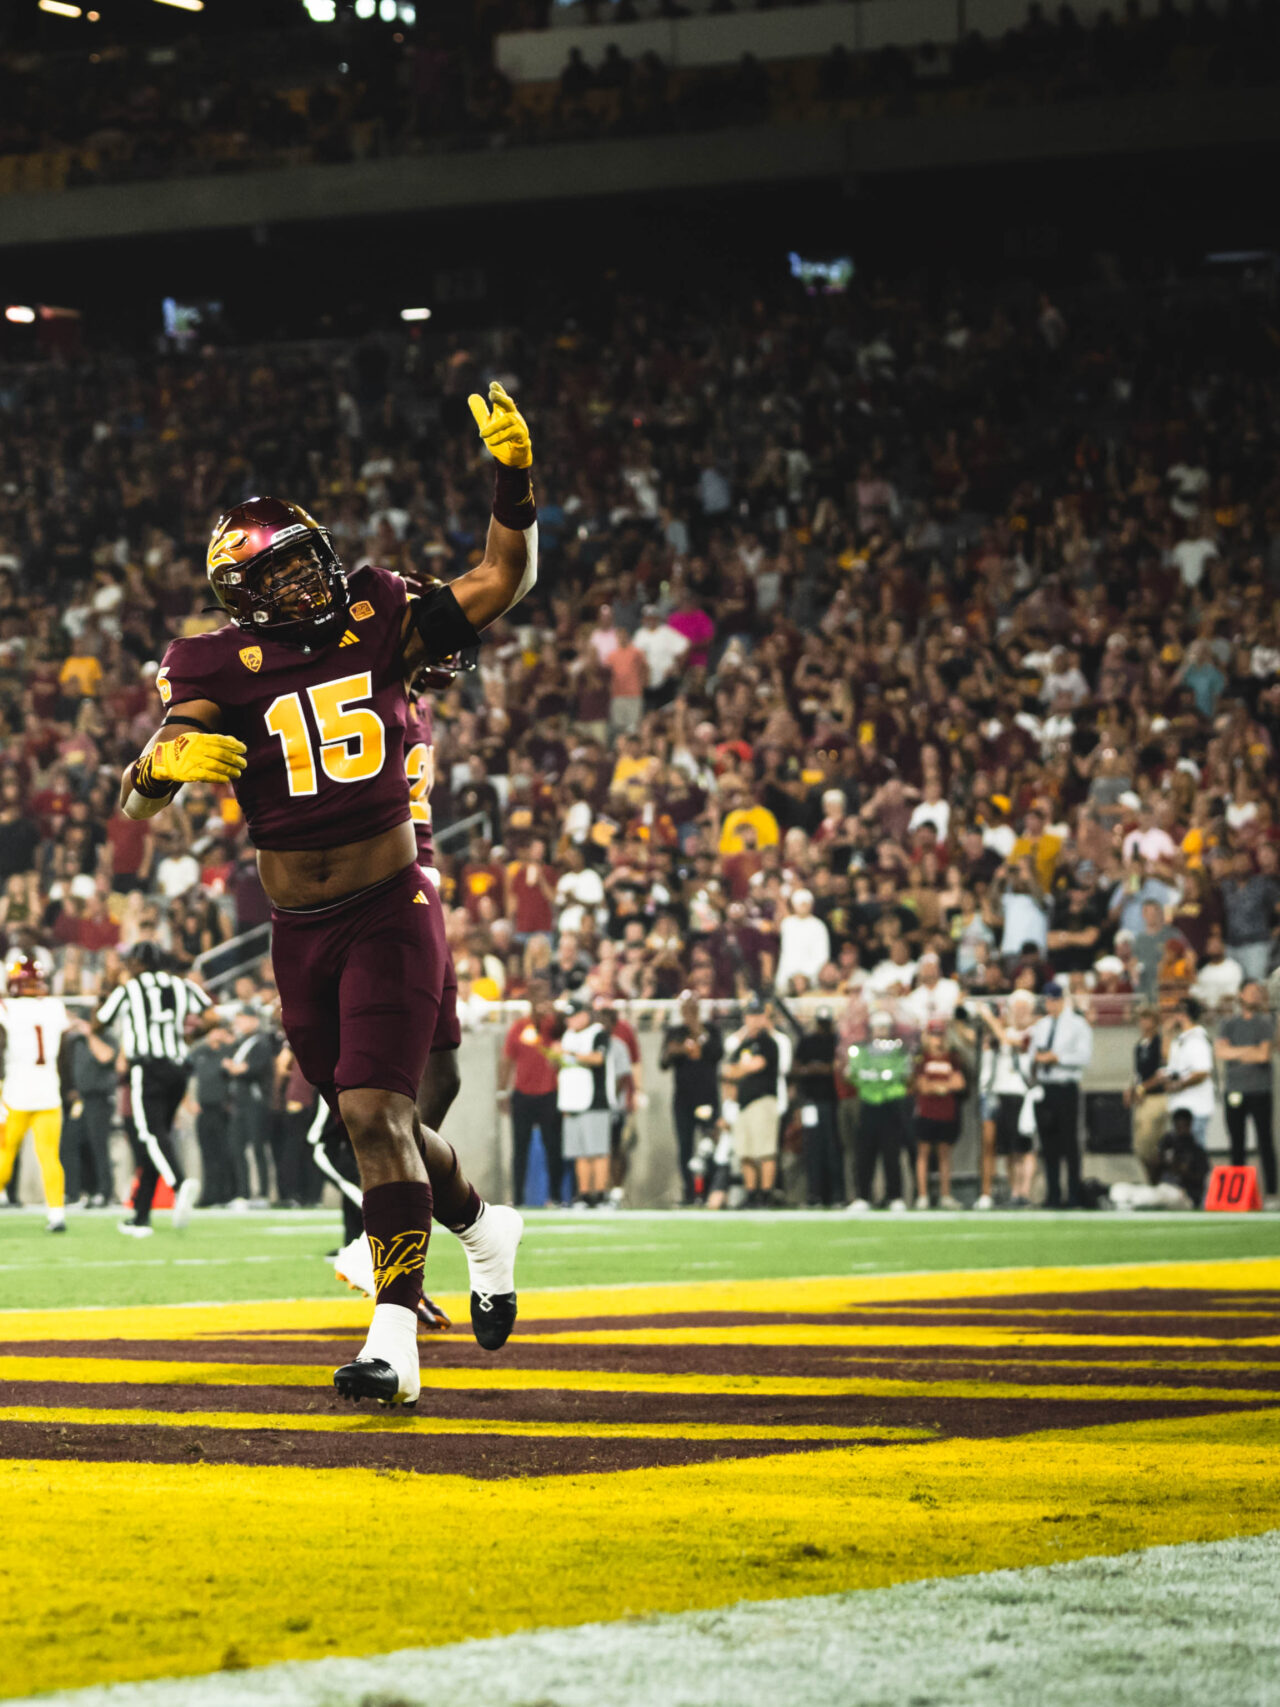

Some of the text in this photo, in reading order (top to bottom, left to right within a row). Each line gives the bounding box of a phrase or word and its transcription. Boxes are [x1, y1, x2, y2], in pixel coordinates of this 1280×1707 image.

[264, 671, 386, 797] 15
[35, 1025, 46, 1065] 1
[1217, 1173, 1246, 1204] 10
